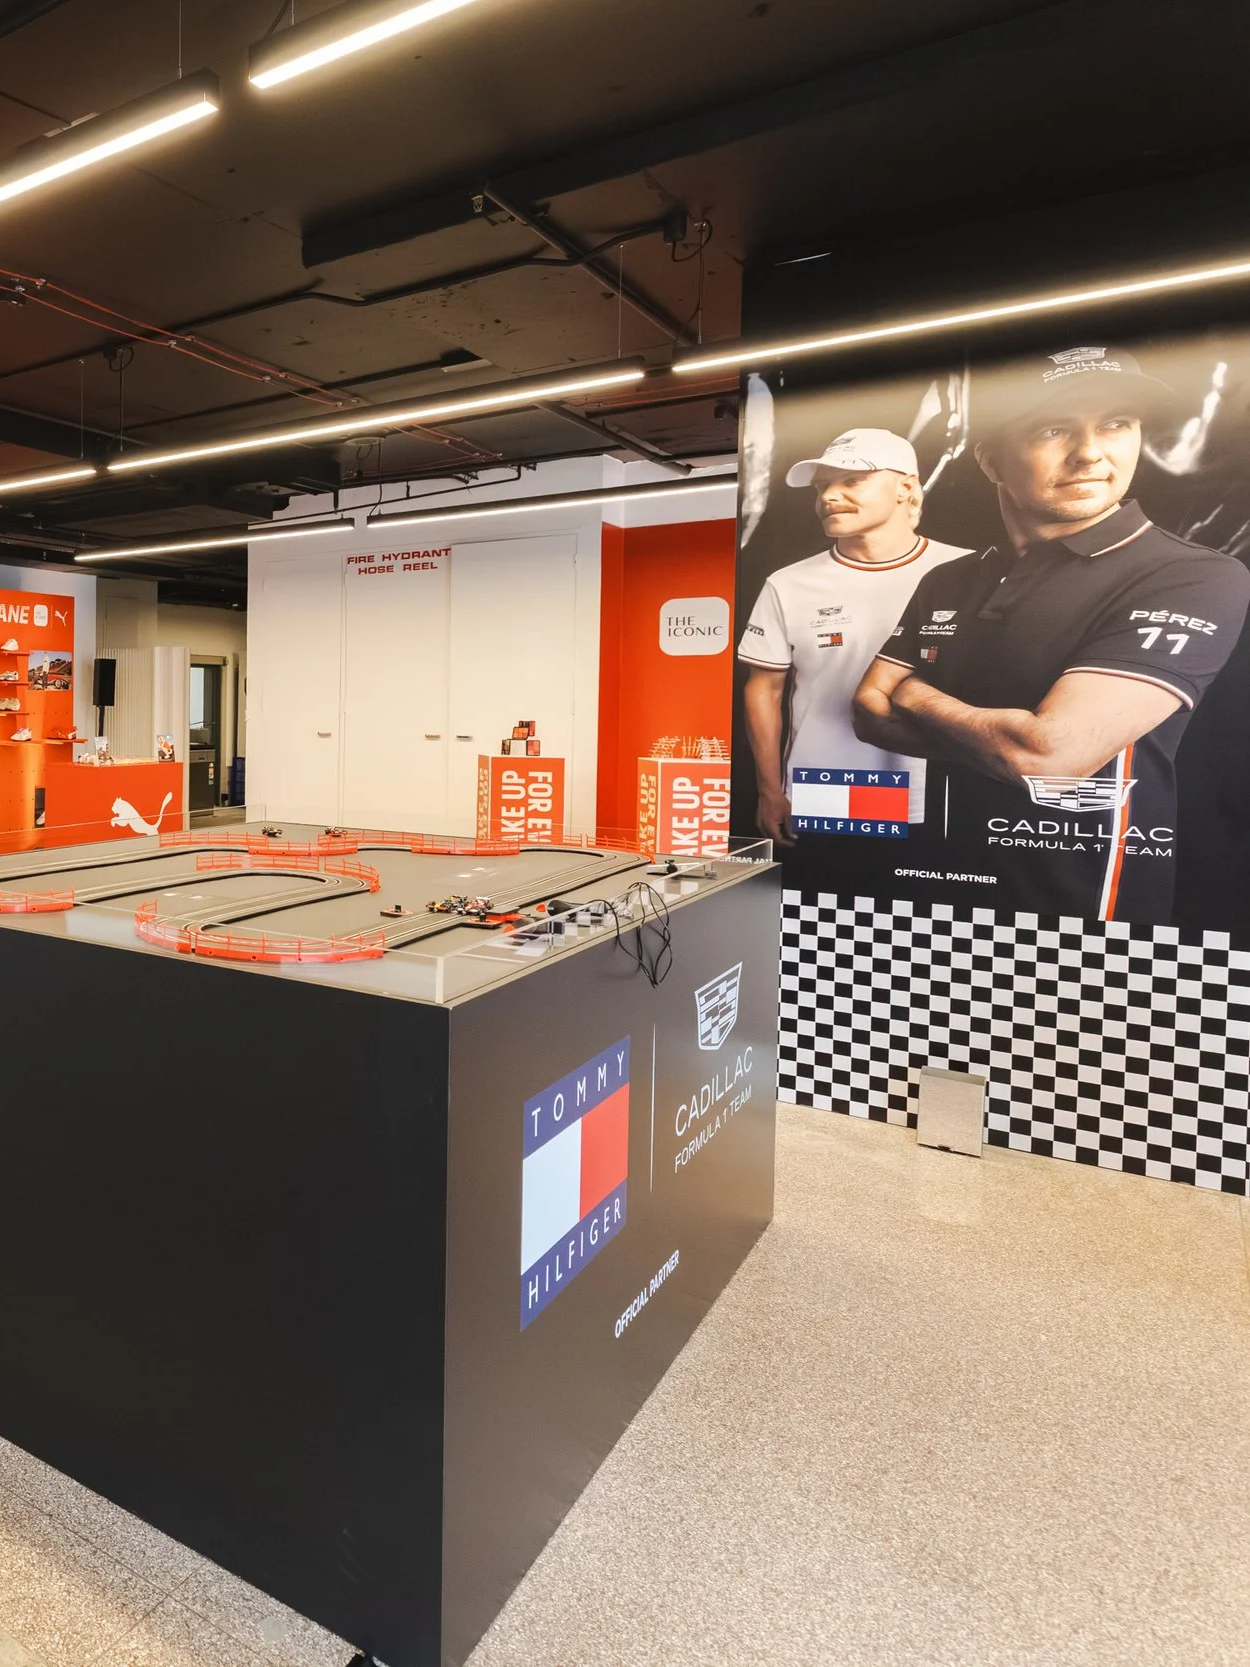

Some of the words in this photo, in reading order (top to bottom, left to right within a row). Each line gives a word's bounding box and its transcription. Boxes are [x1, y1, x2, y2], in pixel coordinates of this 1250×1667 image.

[347, 555, 375, 564] FIRE
[382, 548, 451, 562] HYDRANT
[358, 565, 394, 575] HOSE
[403, 562, 438, 571] REEL
[666, 616, 695, 626] THE
[668, 626, 723, 637] ICONIC
[1129, 609, 1218, 636] PÉREZ
[1137, 627, 1190, 655] 11
[501, 770, 526, 799] UP
[800, 771, 902, 785] TOMMY
[527, 772, 553, 812] FOR
[672, 777, 700, 809] UP
[702, 778, 730, 823] FOR
[798, 819, 900, 834] HILFIGER
[987, 818, 1174, 842] CADILLAC
[988, 837, 1086, 852] FORMULA
[894, 868, 944, 880] OFFICIAL
[946, 872, 997, 884] PARTNER
[531, 1050, 625, 1137] TOMMY
[675, 1046, 753, 1137] CADILLAC
[675, 1115, 721, 1173] FORMULA
[730, 1083, 752, 1117] TEAM
[528, 1197, 622, 1309] HILFIGER
[614, 1287, 649, 1338] OFFICIAL
[649, 1249, 679, 1297] PARTNER
